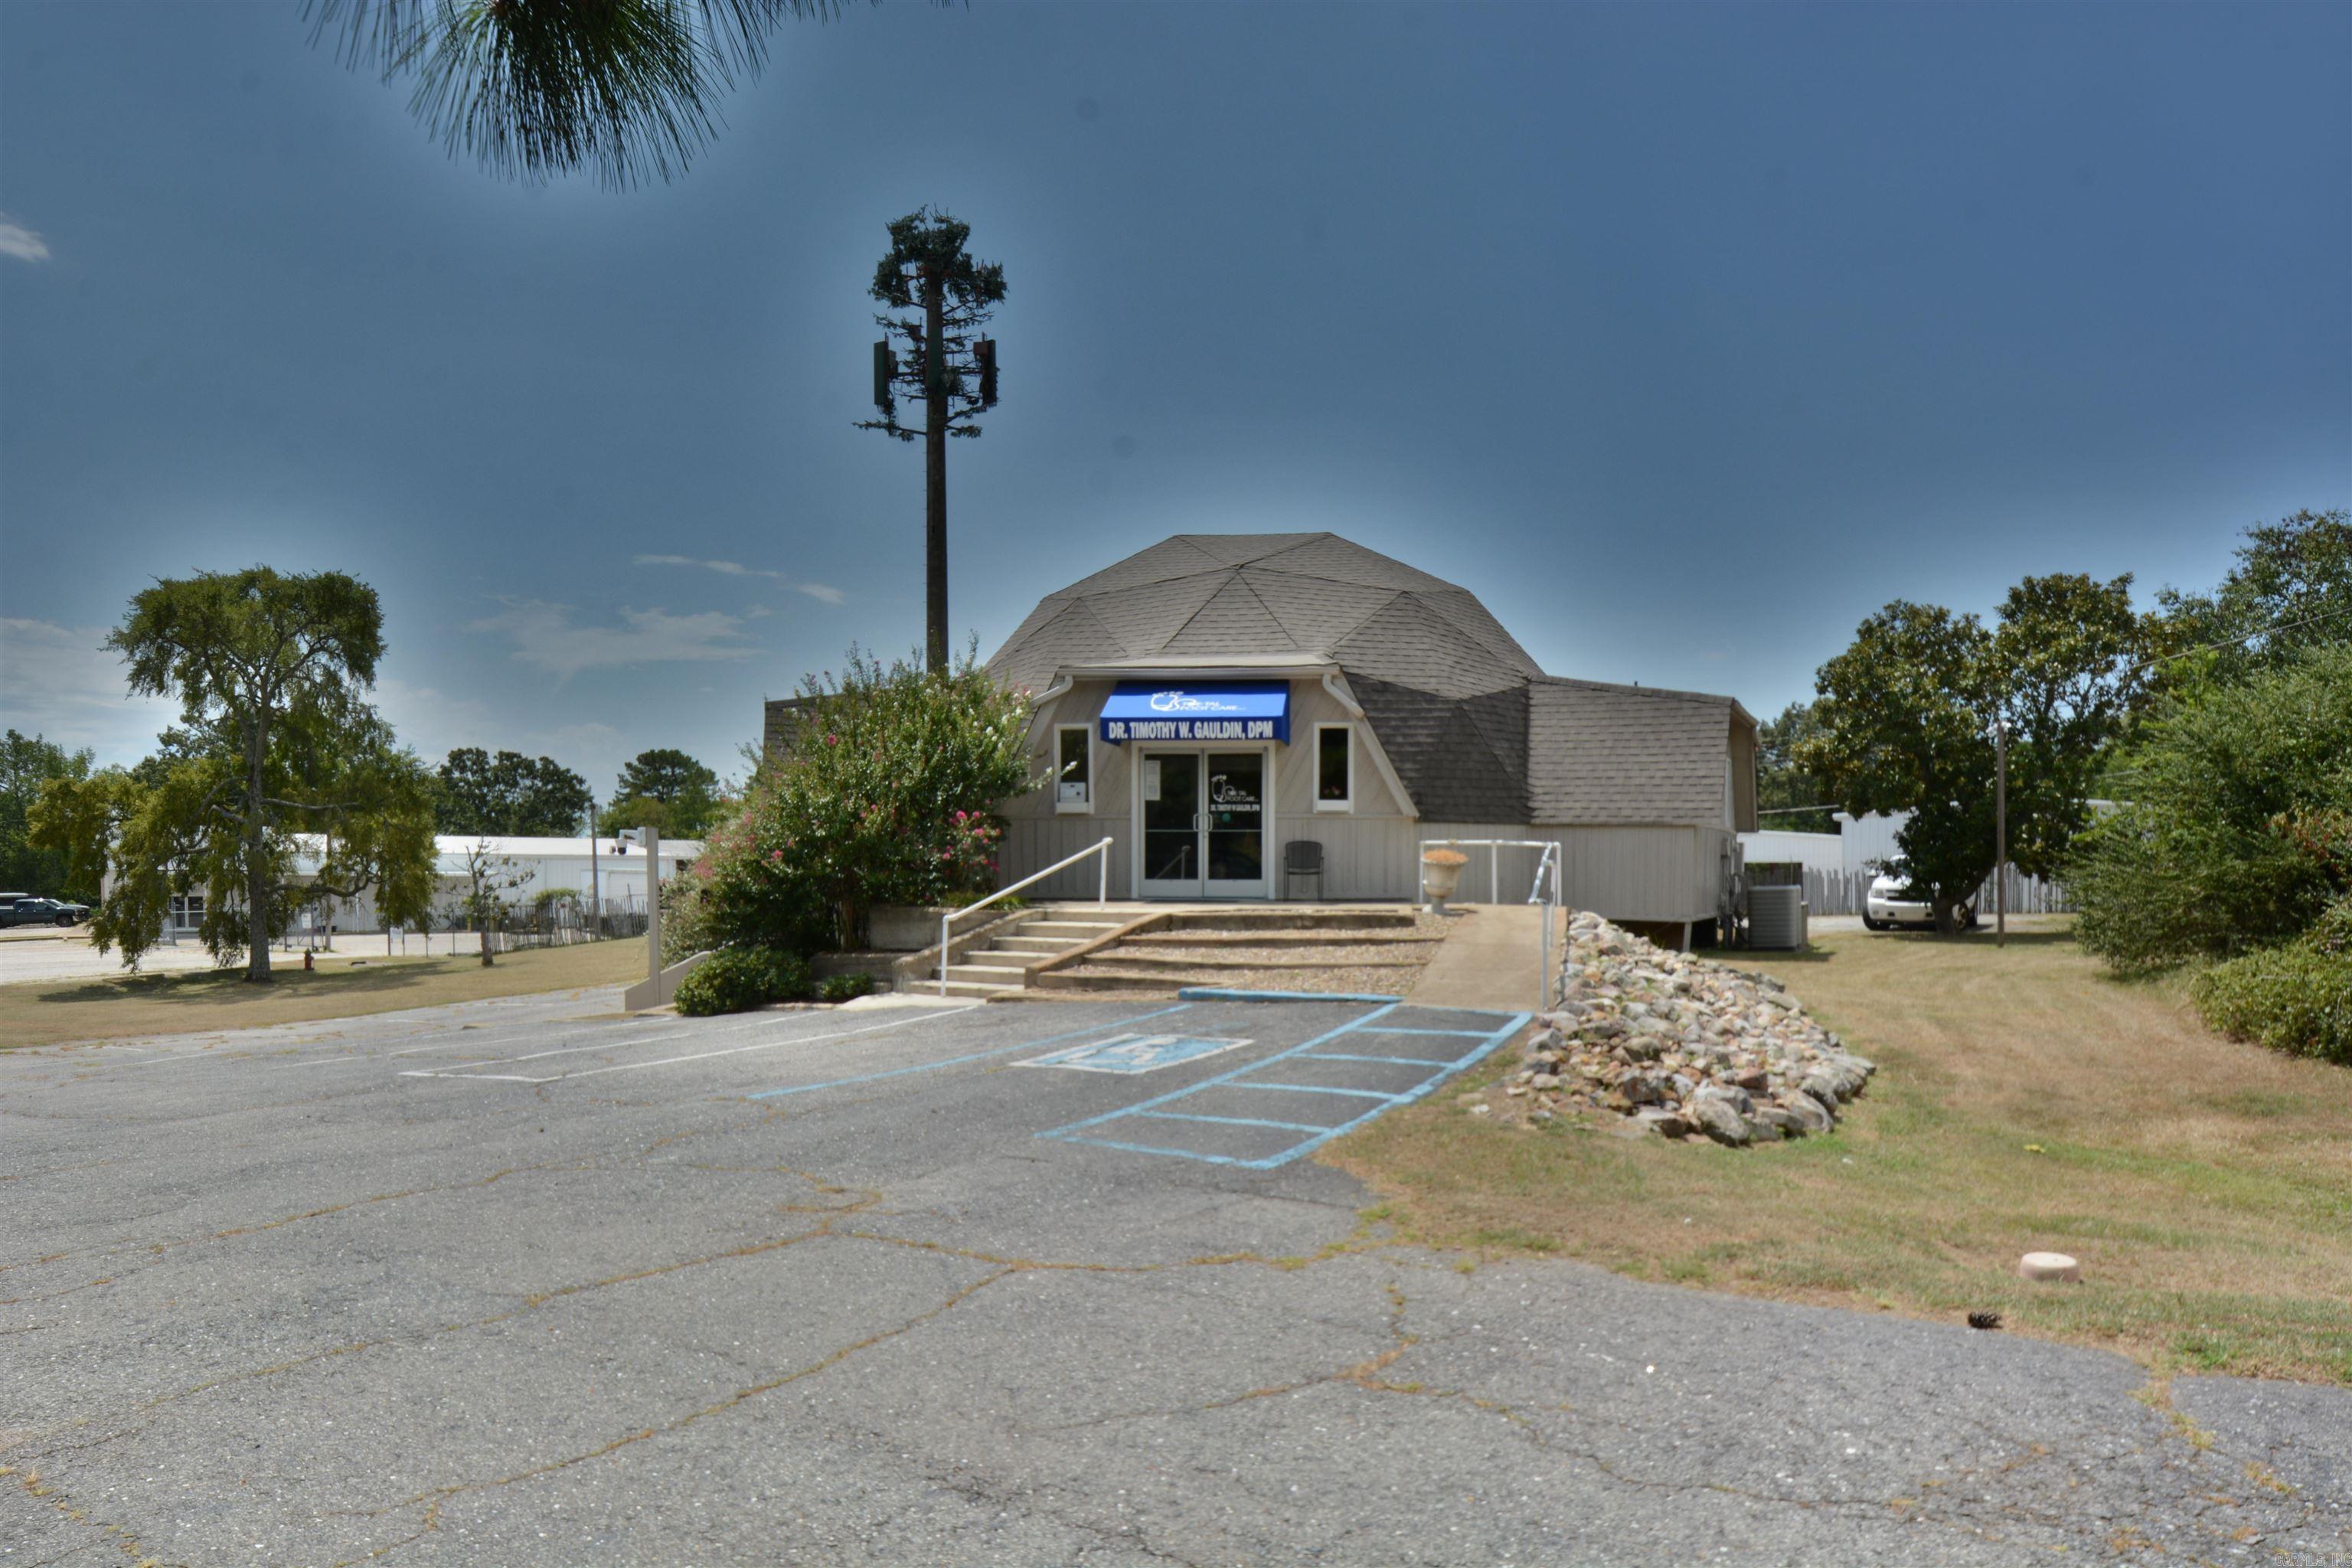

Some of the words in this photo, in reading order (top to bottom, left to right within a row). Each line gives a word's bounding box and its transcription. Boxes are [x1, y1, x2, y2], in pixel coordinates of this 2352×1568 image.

[1109, 721, 1128, 739] DR.
[1129, 721, 1177, 739] TIMOTHY
[1178, 721, 1192, 739] W.
[1194, 721, 1246, 740] GAULDIN,
[1247, 720, 1273, 738] DPM
